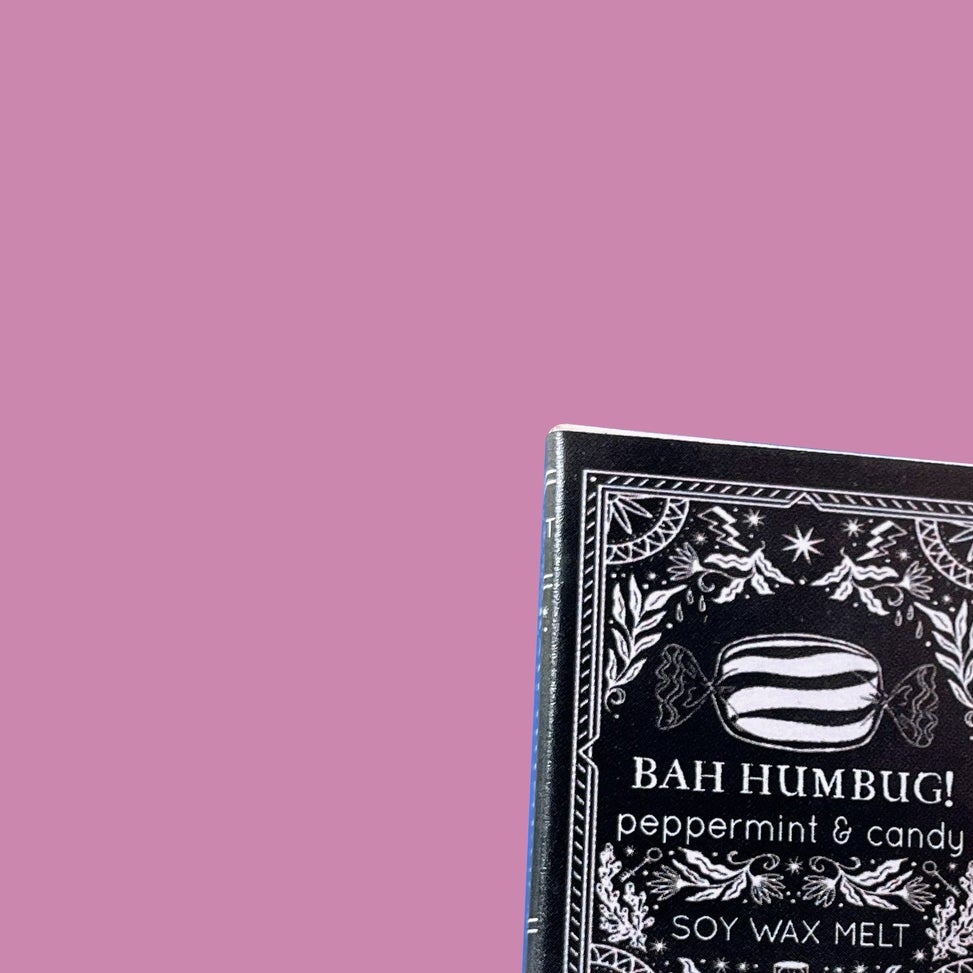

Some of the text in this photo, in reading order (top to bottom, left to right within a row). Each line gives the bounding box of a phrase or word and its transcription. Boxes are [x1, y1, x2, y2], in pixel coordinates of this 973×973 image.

[631, 756, 954, 808] BAH HUMBUG!
[617, 813, 964, 858] peppermint & candy
[671, 914, 911, 948] SOY WAX MELT
